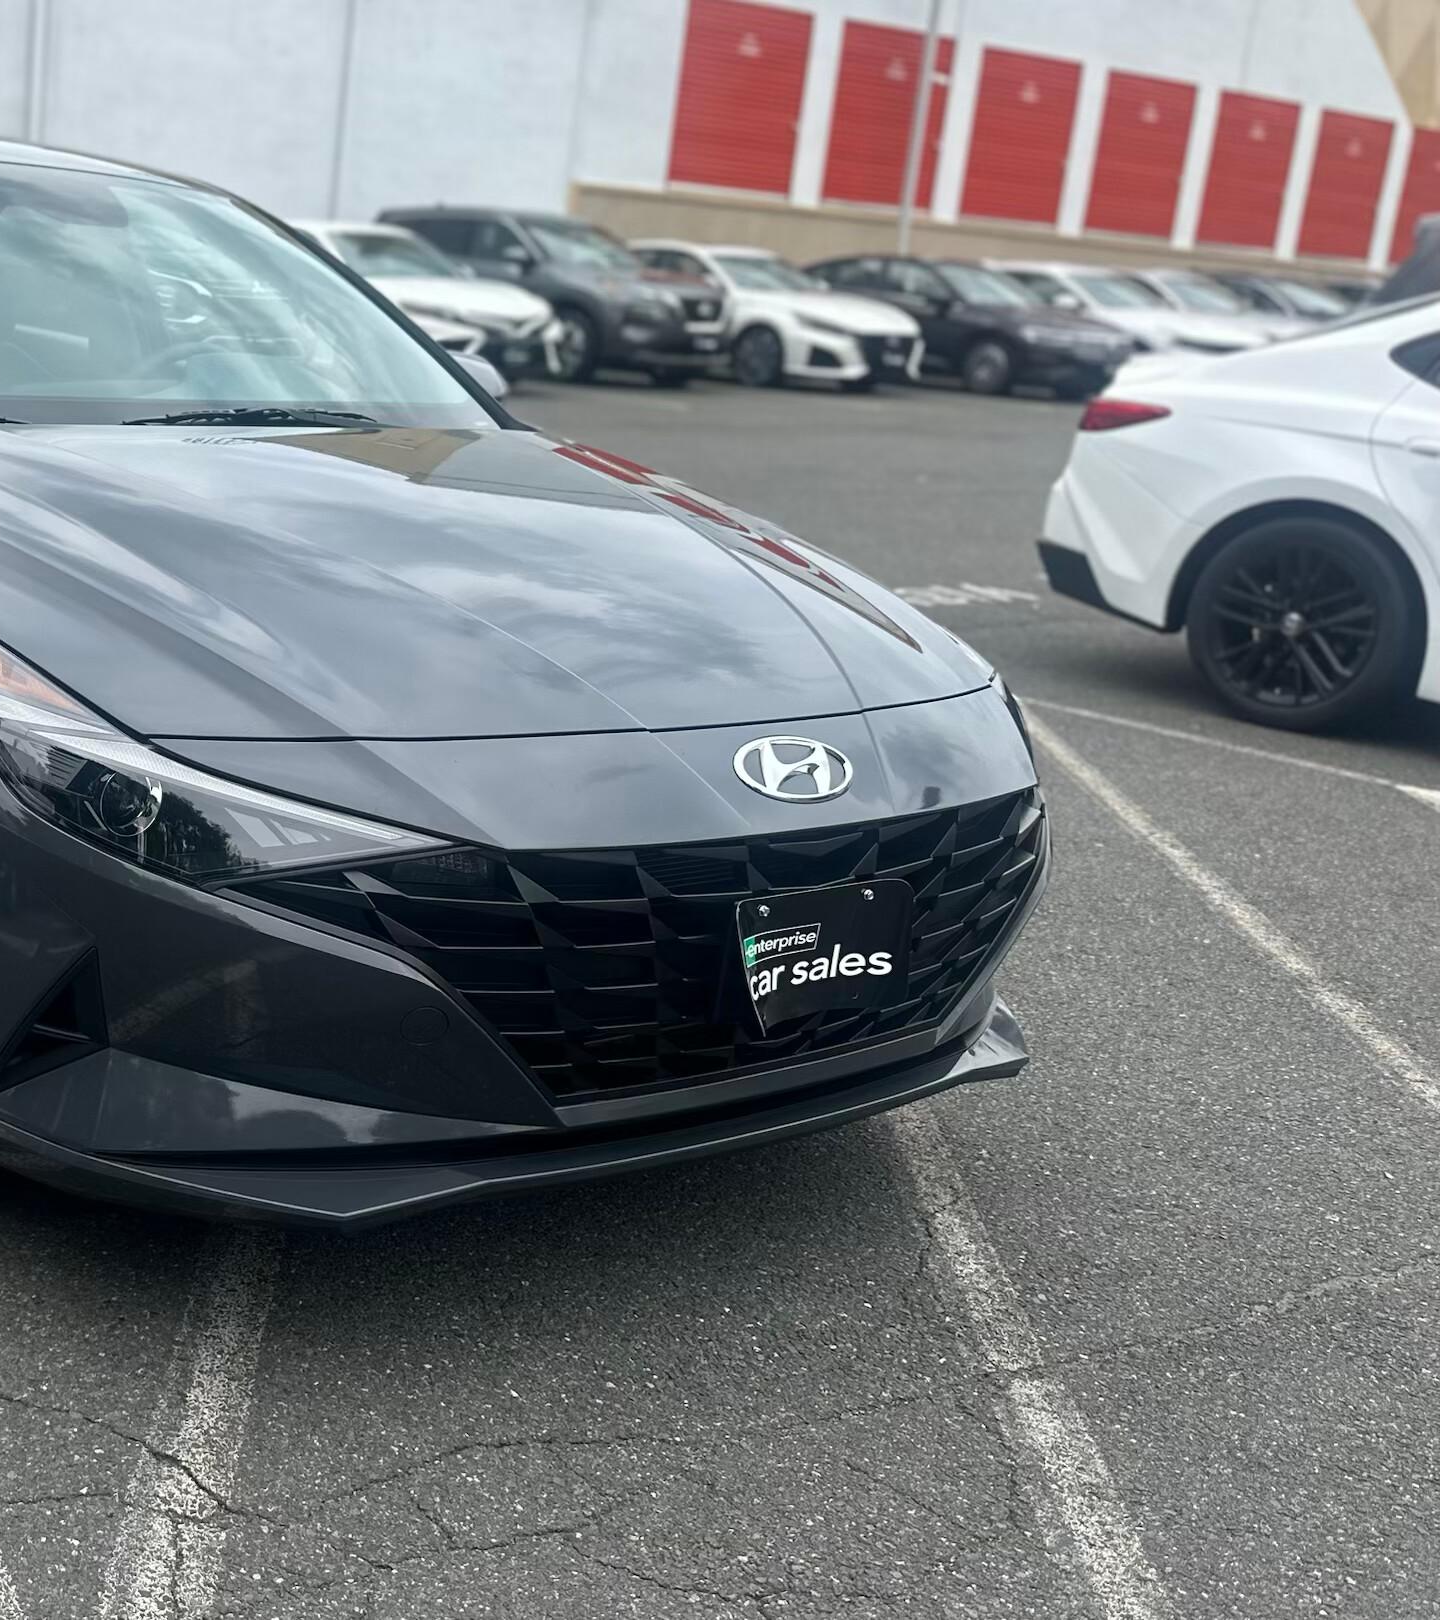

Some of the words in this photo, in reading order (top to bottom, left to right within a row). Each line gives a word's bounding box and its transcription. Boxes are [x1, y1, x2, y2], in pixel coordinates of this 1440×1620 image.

[745, 931, 817, 958] enterprise
[749, 965, 786, 1001] car
[790, 943, 893, 985] sales
